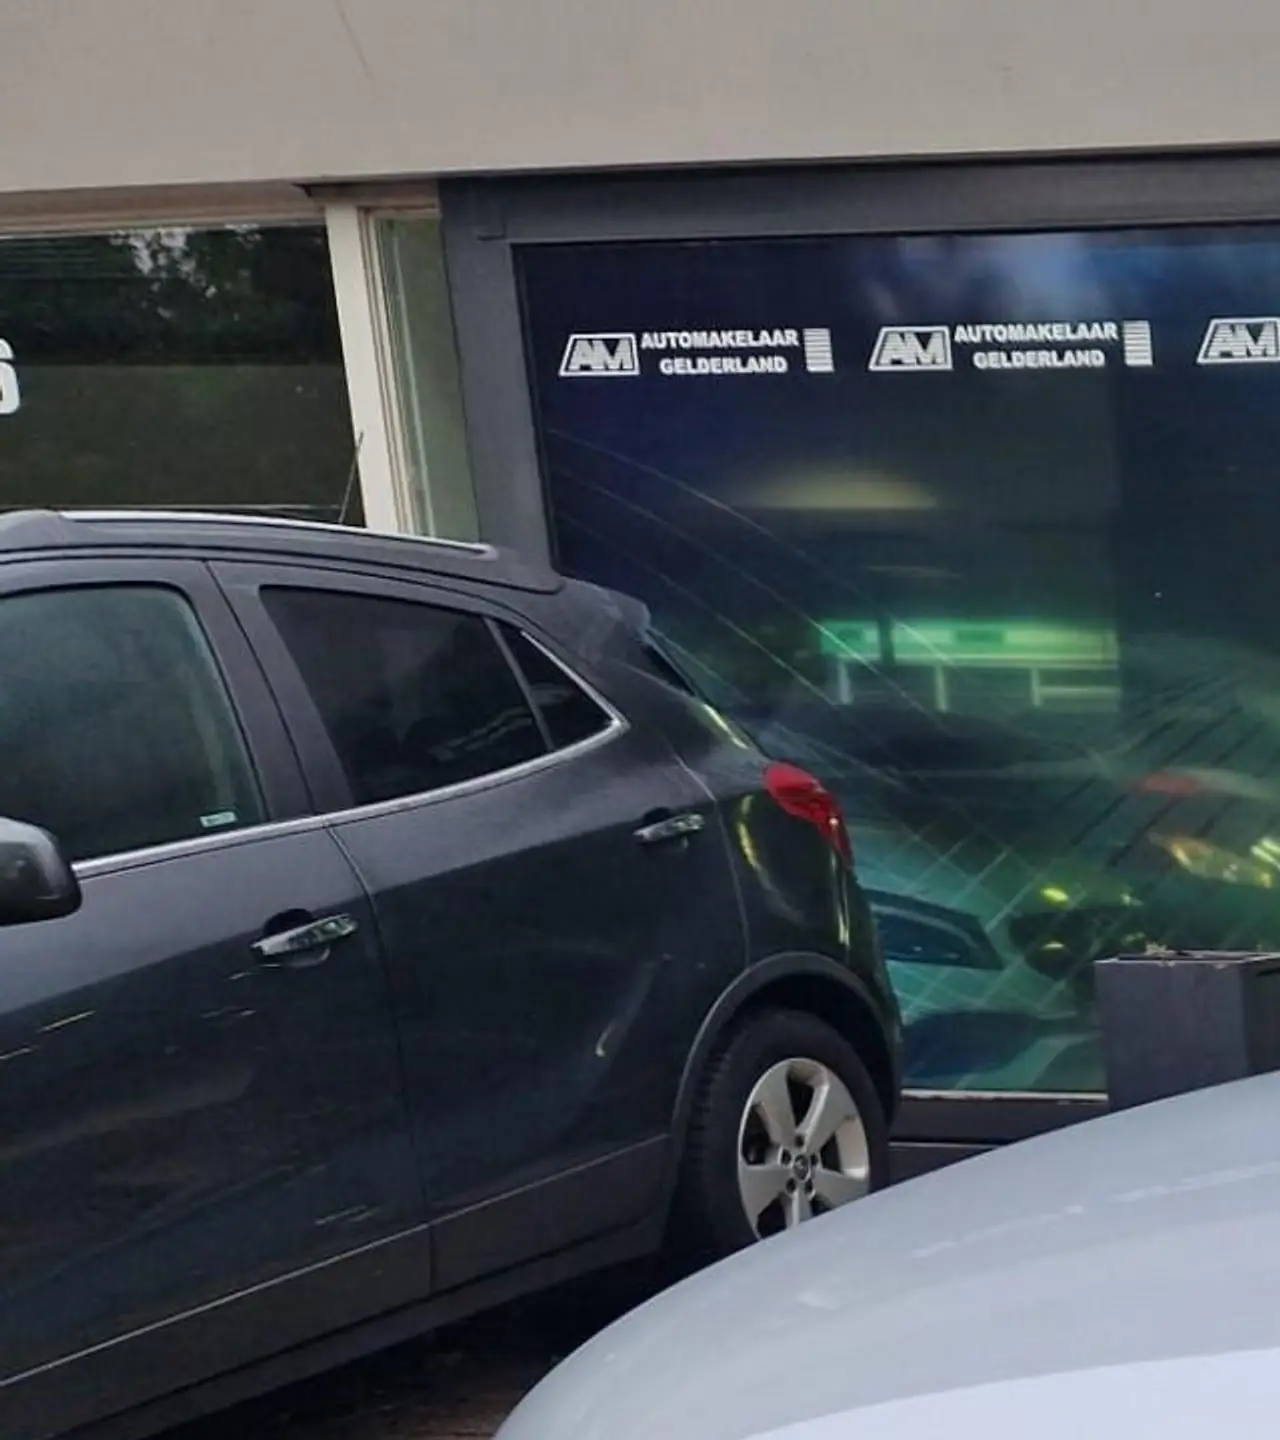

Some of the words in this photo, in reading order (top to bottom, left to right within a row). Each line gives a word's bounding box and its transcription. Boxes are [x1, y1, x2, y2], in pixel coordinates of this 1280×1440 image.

[641, 329, 799, 349] AUTOMAKELAAR
[954, 321, 1118, 343] AUTOMAKELAAR
[1206, 322, 1277, 359] AM
[567, 338, 635, 371] AM
[878, 332, 946, 365] AM
[972, 349, 1105, 369] GELDERLAND
[659, 356, 788, 375] GELDERLAND
